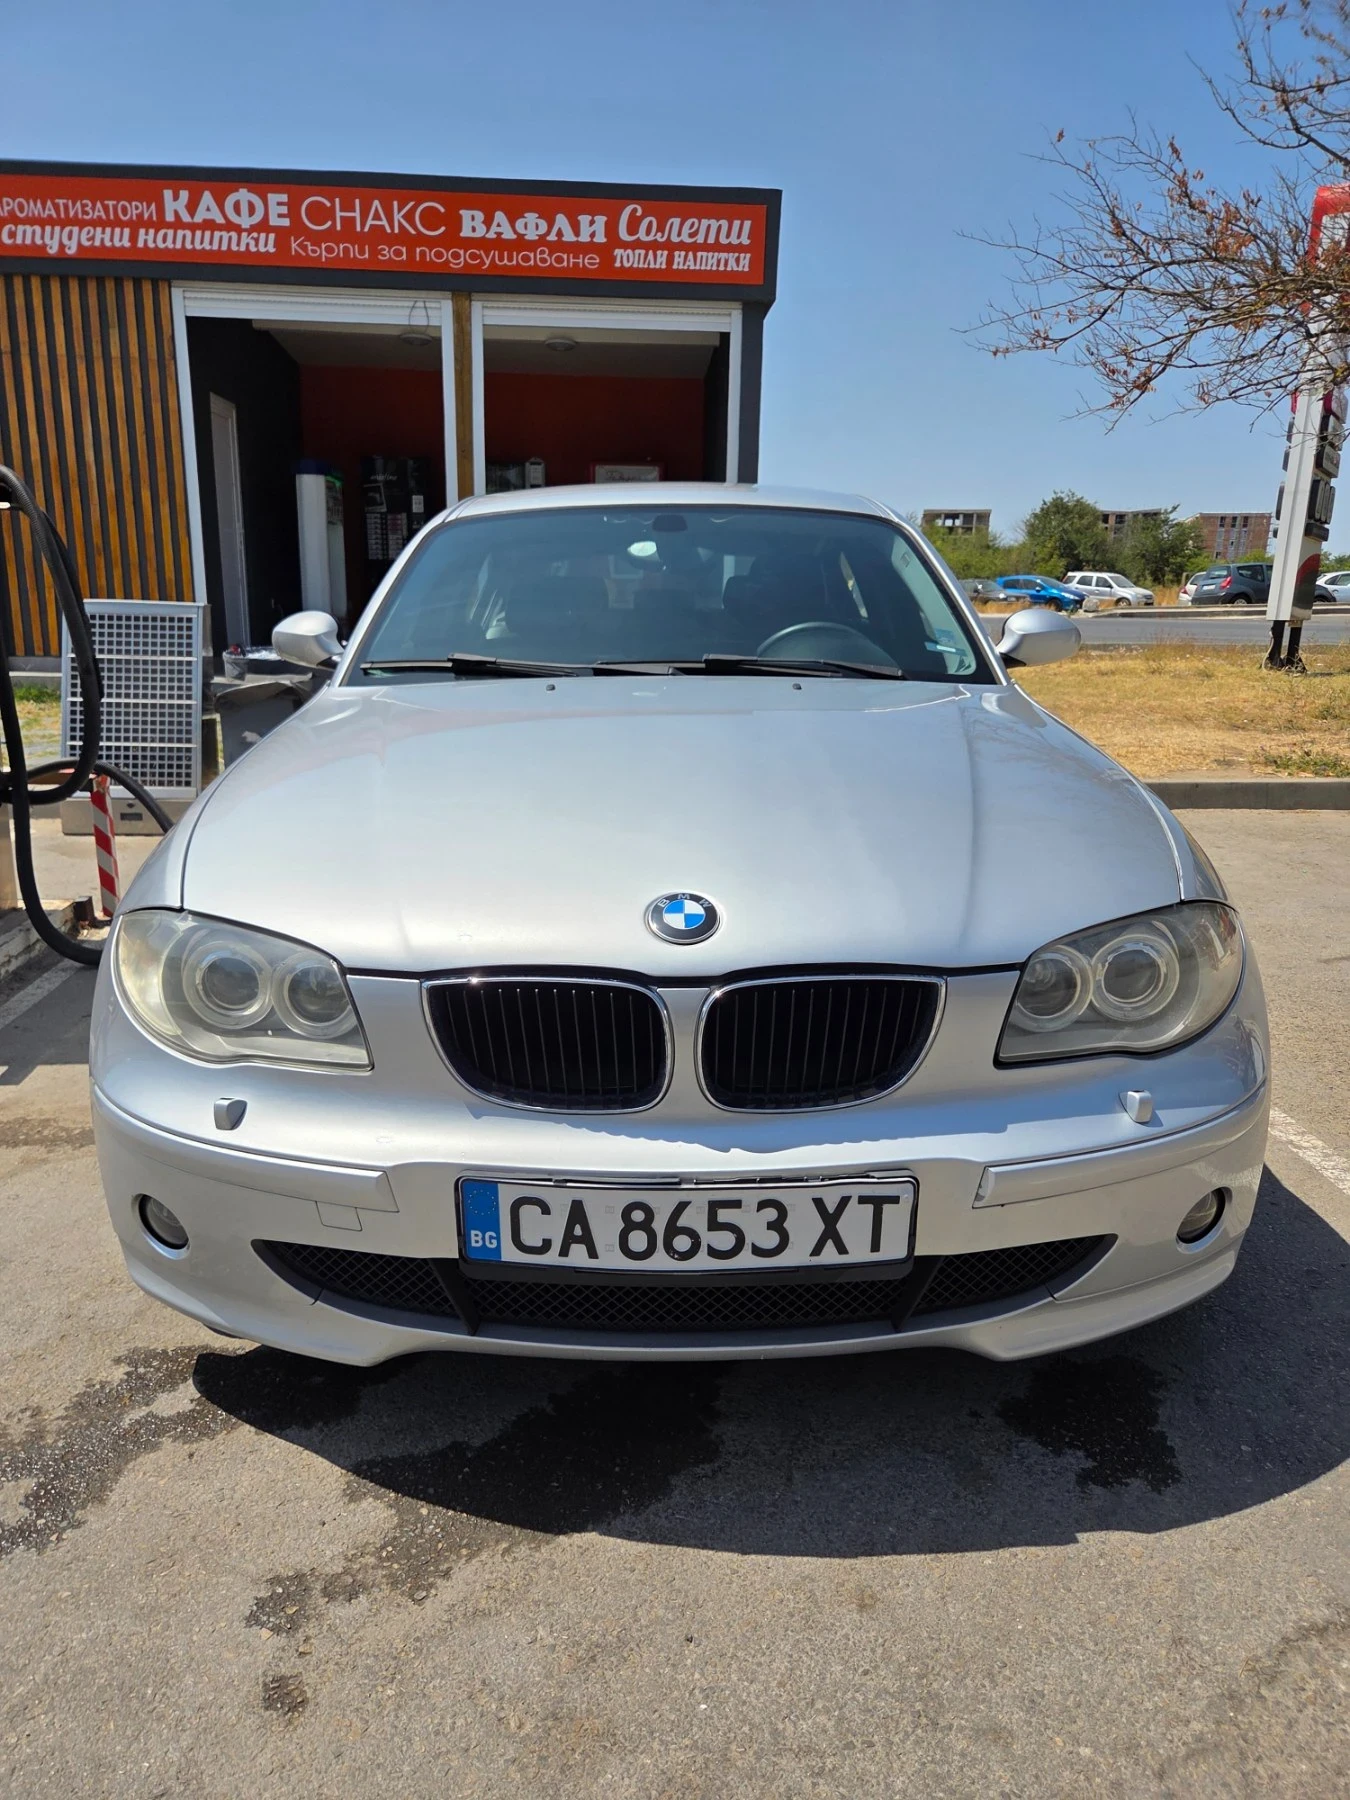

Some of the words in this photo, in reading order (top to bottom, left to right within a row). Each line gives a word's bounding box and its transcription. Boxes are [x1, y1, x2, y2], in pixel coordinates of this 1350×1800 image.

[163, 188, 290, 229] КАФЕ
[301, 195, 446, 236] СНАКС
[459, 208, 607, 243] ВАФЛИ
[618, 204, 751, 246] Солети
[1, 223, 131, 255] студени
[137, 227, 277, 253] напитки
[290, 236, 369, 262] Кърпи
[377, 245, 407, 261] за
[415, 246, 600, 269] подсушаване
[614, 249, 667, 269] ТОПЛИ
[672, 251, 751, 272] НАПИТКИ
[657, 893, 712, 908] BMW
[470, 1230, 497, 1248] BG
[509, 1196, 599, 1259] CA
[618, 1199, 790, 1262] 8653
[809, 1195, 901, 1257] XT
